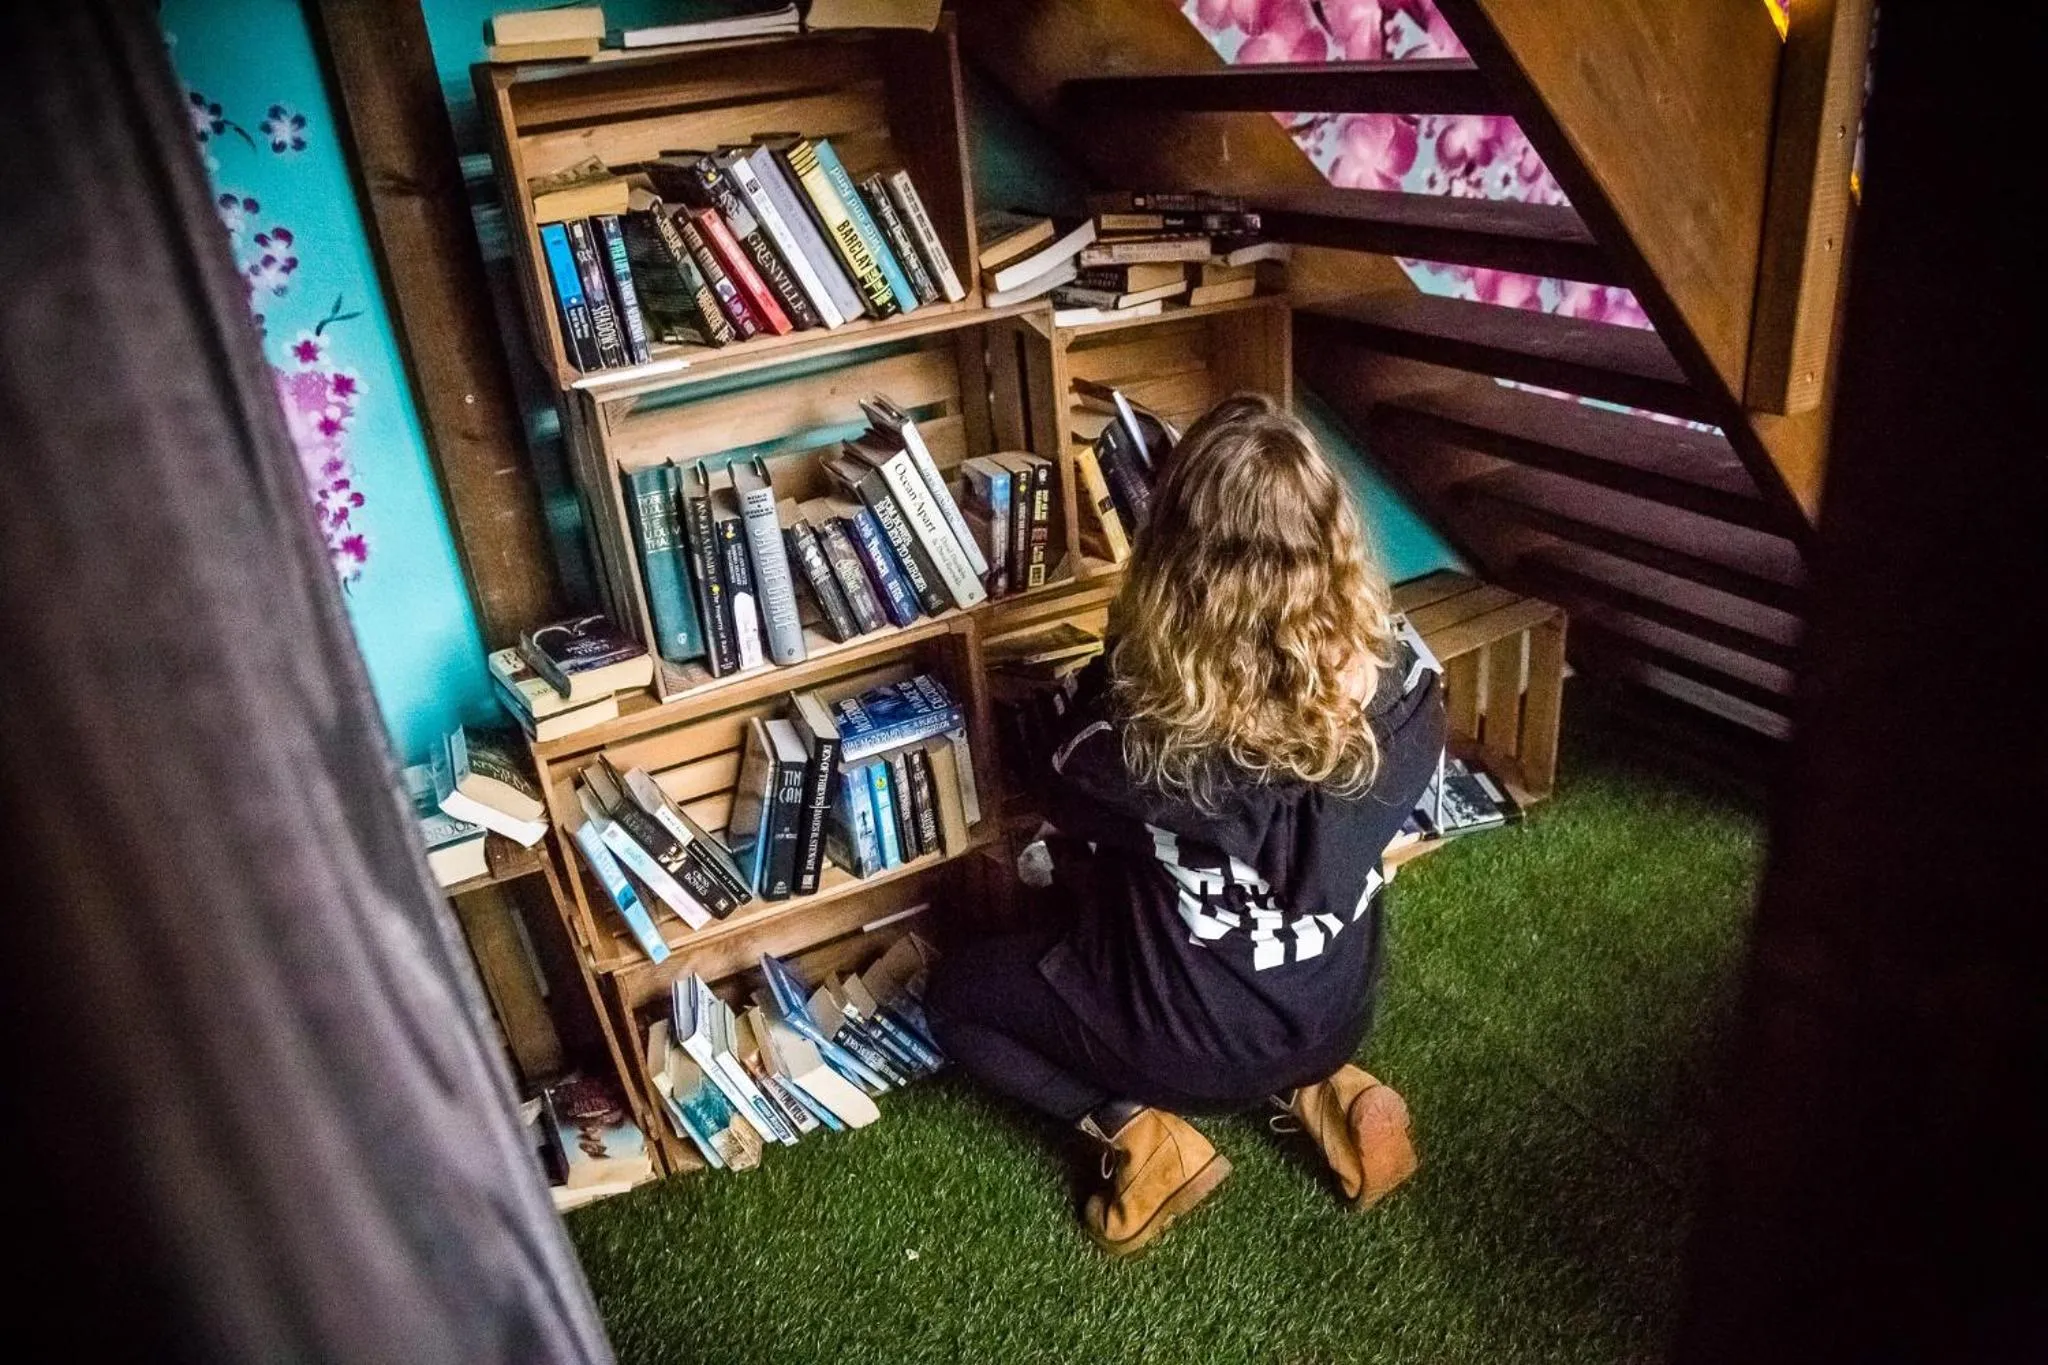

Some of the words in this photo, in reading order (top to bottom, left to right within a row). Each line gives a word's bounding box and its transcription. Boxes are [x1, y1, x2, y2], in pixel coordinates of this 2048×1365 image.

[834, 219, 874, 271] BARCLAY
[744, 229, 806, 315] GRENVILLE
[890, 461, 923, 500] Ocean
[910, 498, 940, 533] Apart
[871, 501, 895, 530] BLIND
[886, 527, 903, 546] EYE
[895, 544, 908, 557] TO
[751, 524, 788, 584] SAVAGE
[900, 554, 929, 592] MURDER
[764, 583, 800, 633] GRACE
[819, 761, 829, 772] OF
[821, 744, 832, 761] DEN
[784, 770, 802, 786] TIN
[814, 772, 827, 806] THIEVES
[779, 786, 802, 804] CAN
[683, 871, 709, 897] BONES
